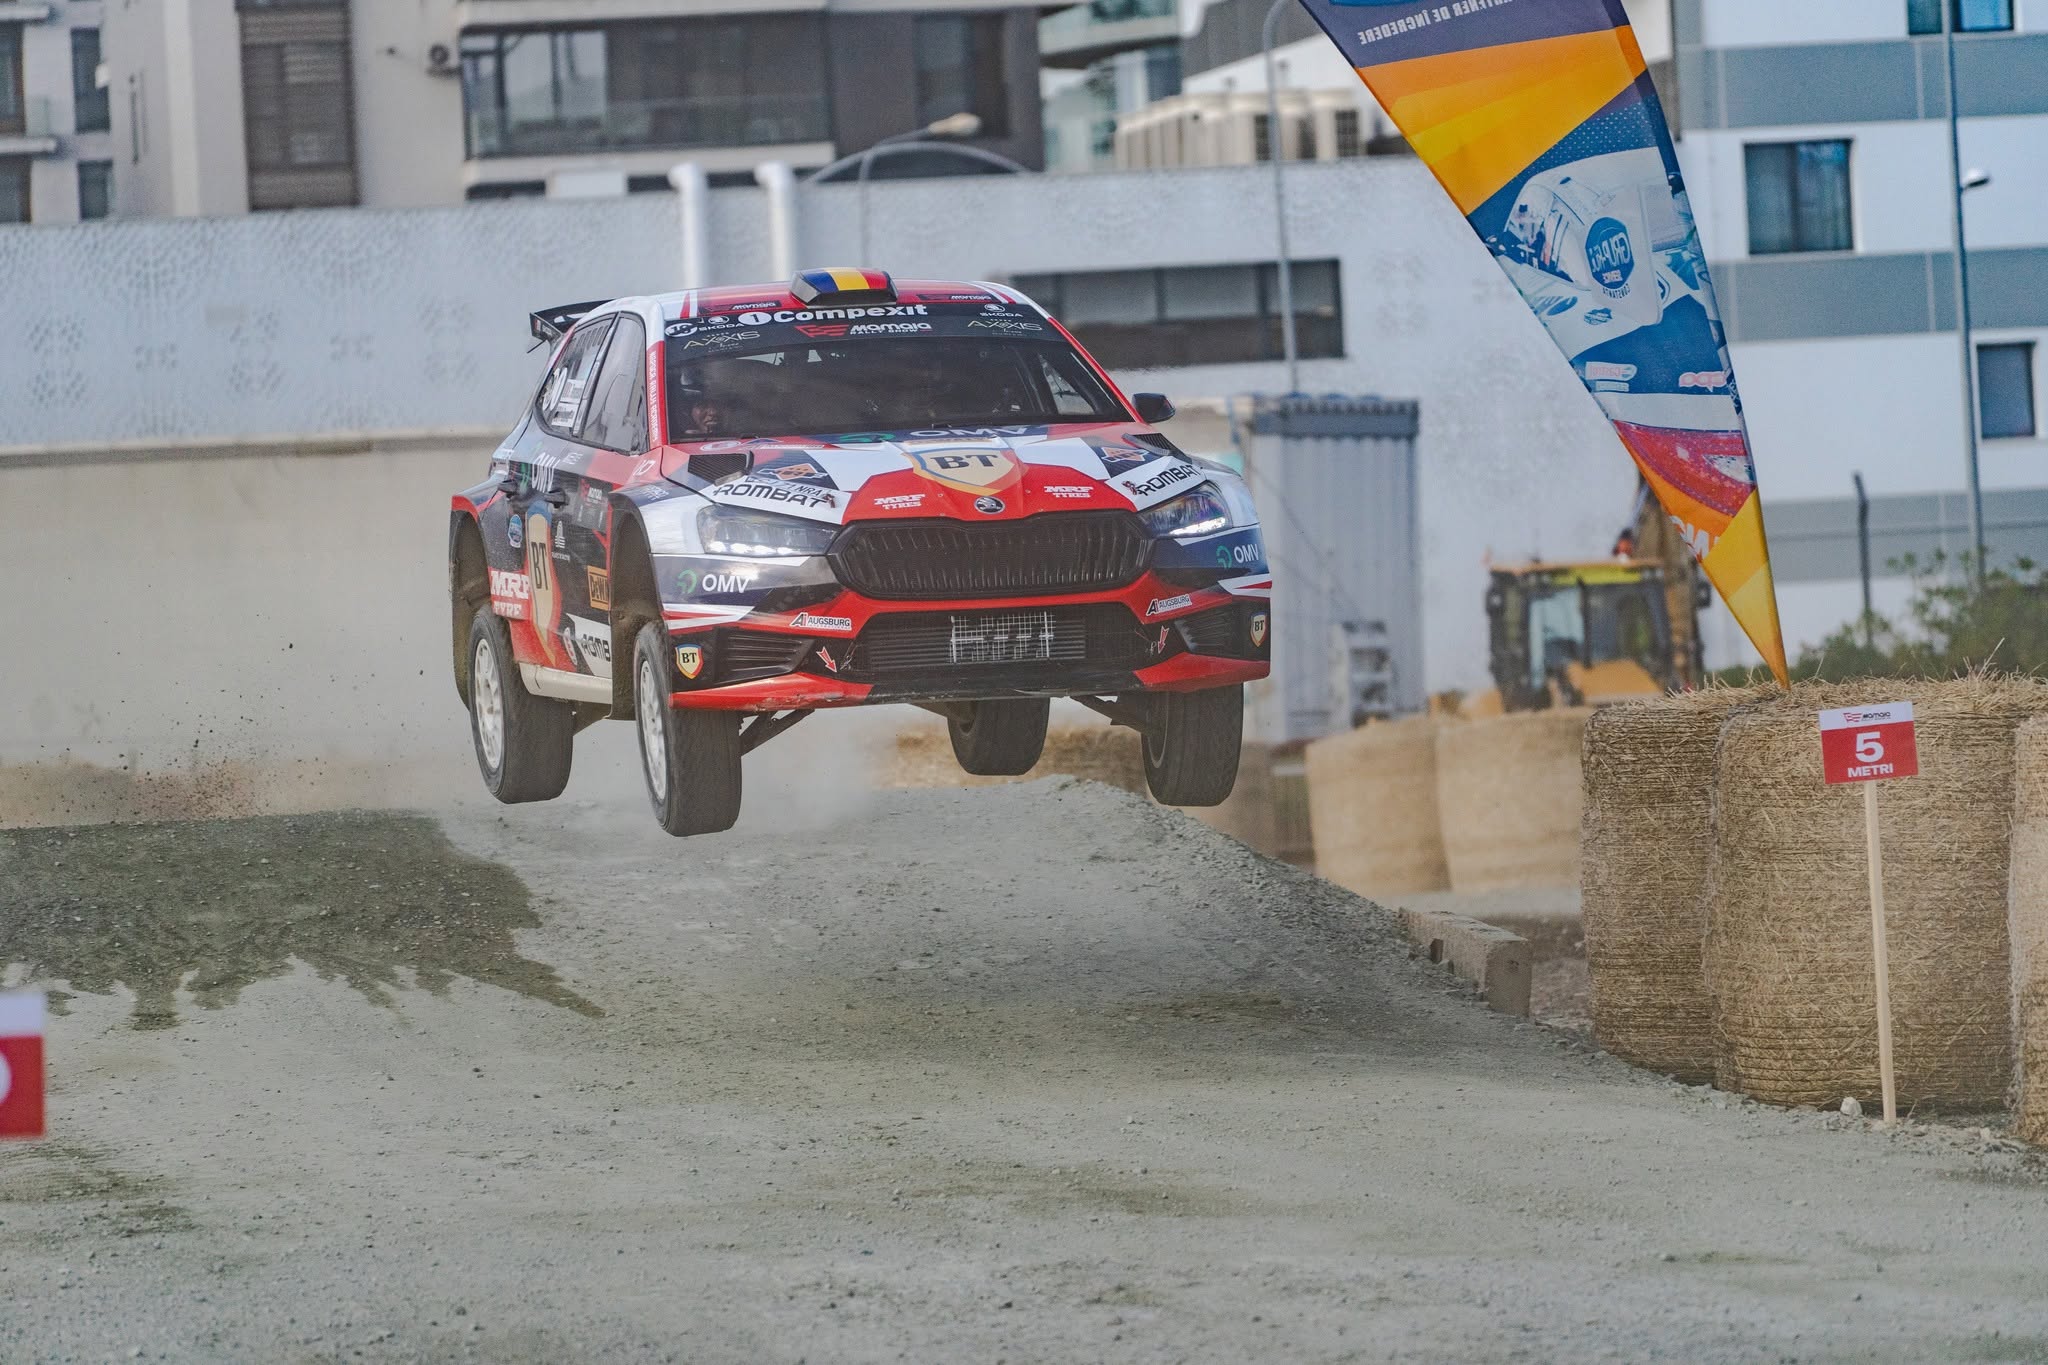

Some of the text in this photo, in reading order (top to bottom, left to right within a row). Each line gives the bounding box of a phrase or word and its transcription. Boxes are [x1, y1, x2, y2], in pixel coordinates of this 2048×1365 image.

[773, 304, 928, 324] Compexit
[910, 427, 1027, 437] OMV
[930, 455, 998, 469] BT
[1136, 464, 1201, 496] ROMBAT
[713, 484, 828, 508] ROMBAT
[1044, 486, 1094, 494] MRF
[874, 494, 926, 506] MRF
[882, 501, 922, 510] TYRES
[1233, 544, 1259, 563] OMV
[531, 542, 548, 590] BT
[702, 573, 750, 593] OMV
[1159, 595, 1190, 608] AUGSBURG
[807, 616, 850, 627] AUGSBURG
[1254, 620, 1264, 632] BT
[682, 651, 697, 664] BT
[1855, 731, 1884, 763] 5
[1847, 763, 1894, 778] METRI
